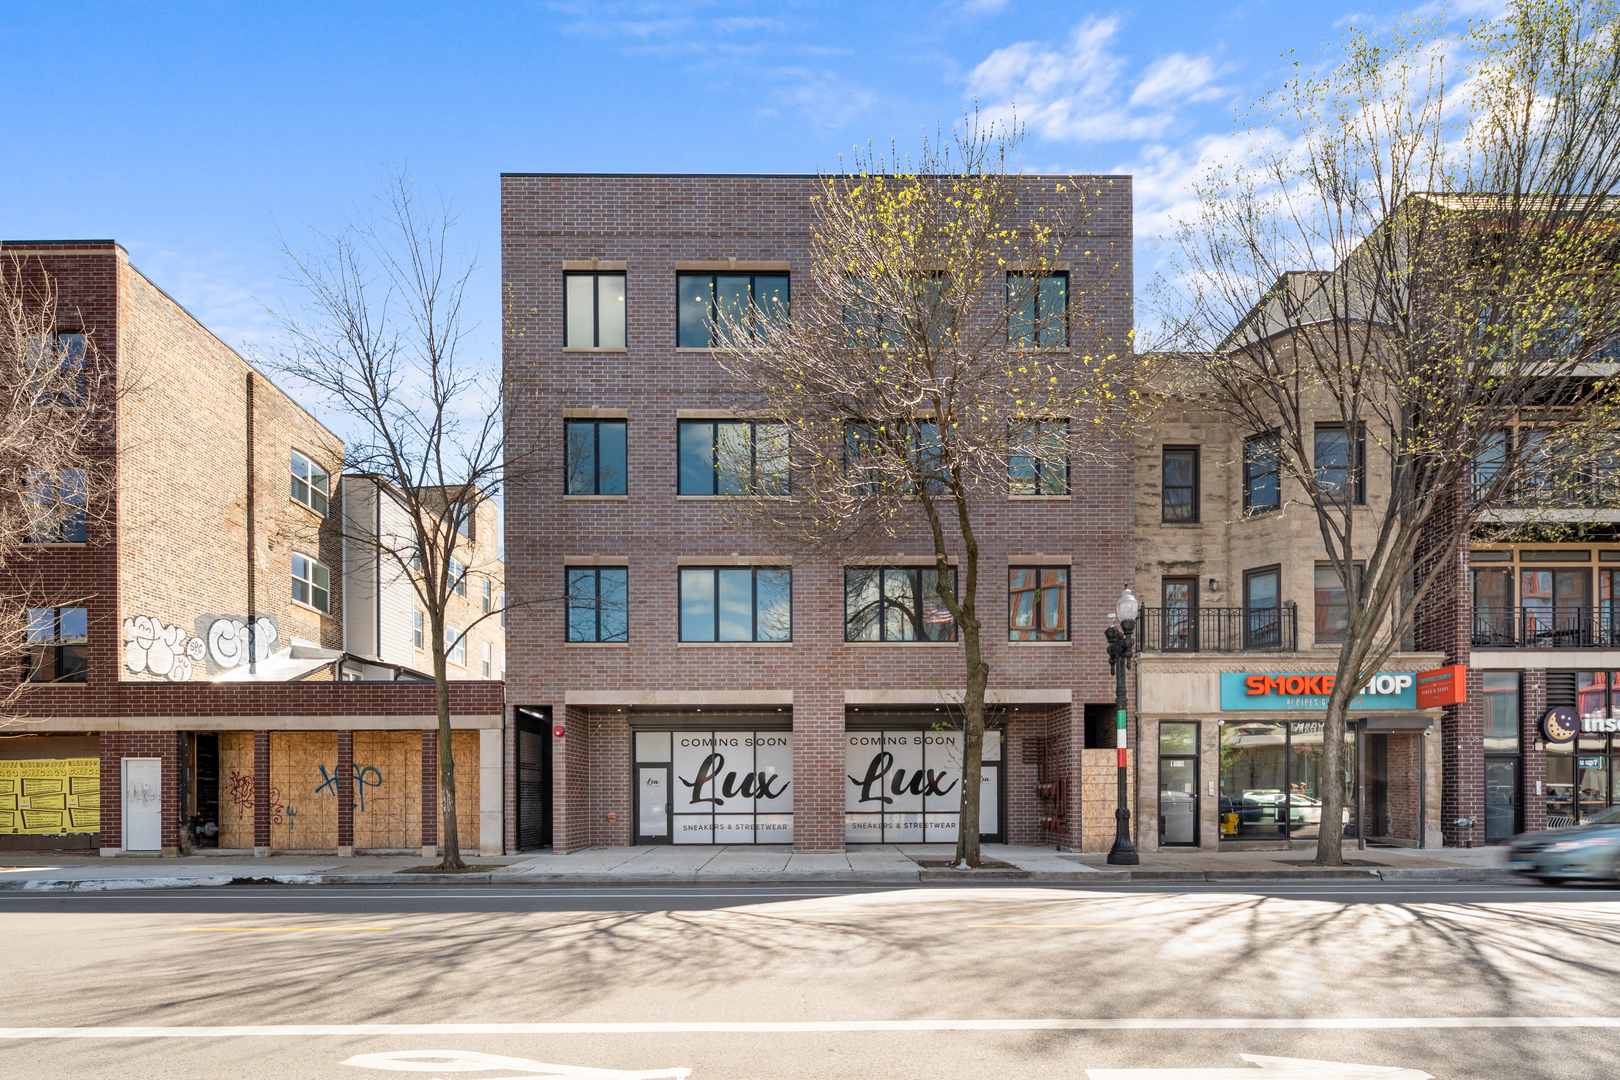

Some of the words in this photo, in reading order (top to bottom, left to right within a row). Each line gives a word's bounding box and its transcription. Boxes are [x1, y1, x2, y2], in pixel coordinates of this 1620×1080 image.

[1245, 675, 1337, 695] SMOKE
[1358, 675, 1412, 695] HOP
[1296, 698, 1319, 707] PIPES
[681, 738, 739, 748] COMING
[744, 737, 788, 747] SOON
[849, 736, 908, 746] COMING
[913, 736, 956, 746] SOON
[1463, 735, 1480, 743] 1335
[20, 767, 67, 778] CHICAGO
[678, 752, 791, 806] Lux
[847, 751, 960, 805] Lux
[683, 824, 725, 832] SNEAKERS
[735, 823, 788, 831] STREETWEAR
[852, 822, 893, 830] SNEAKERS
